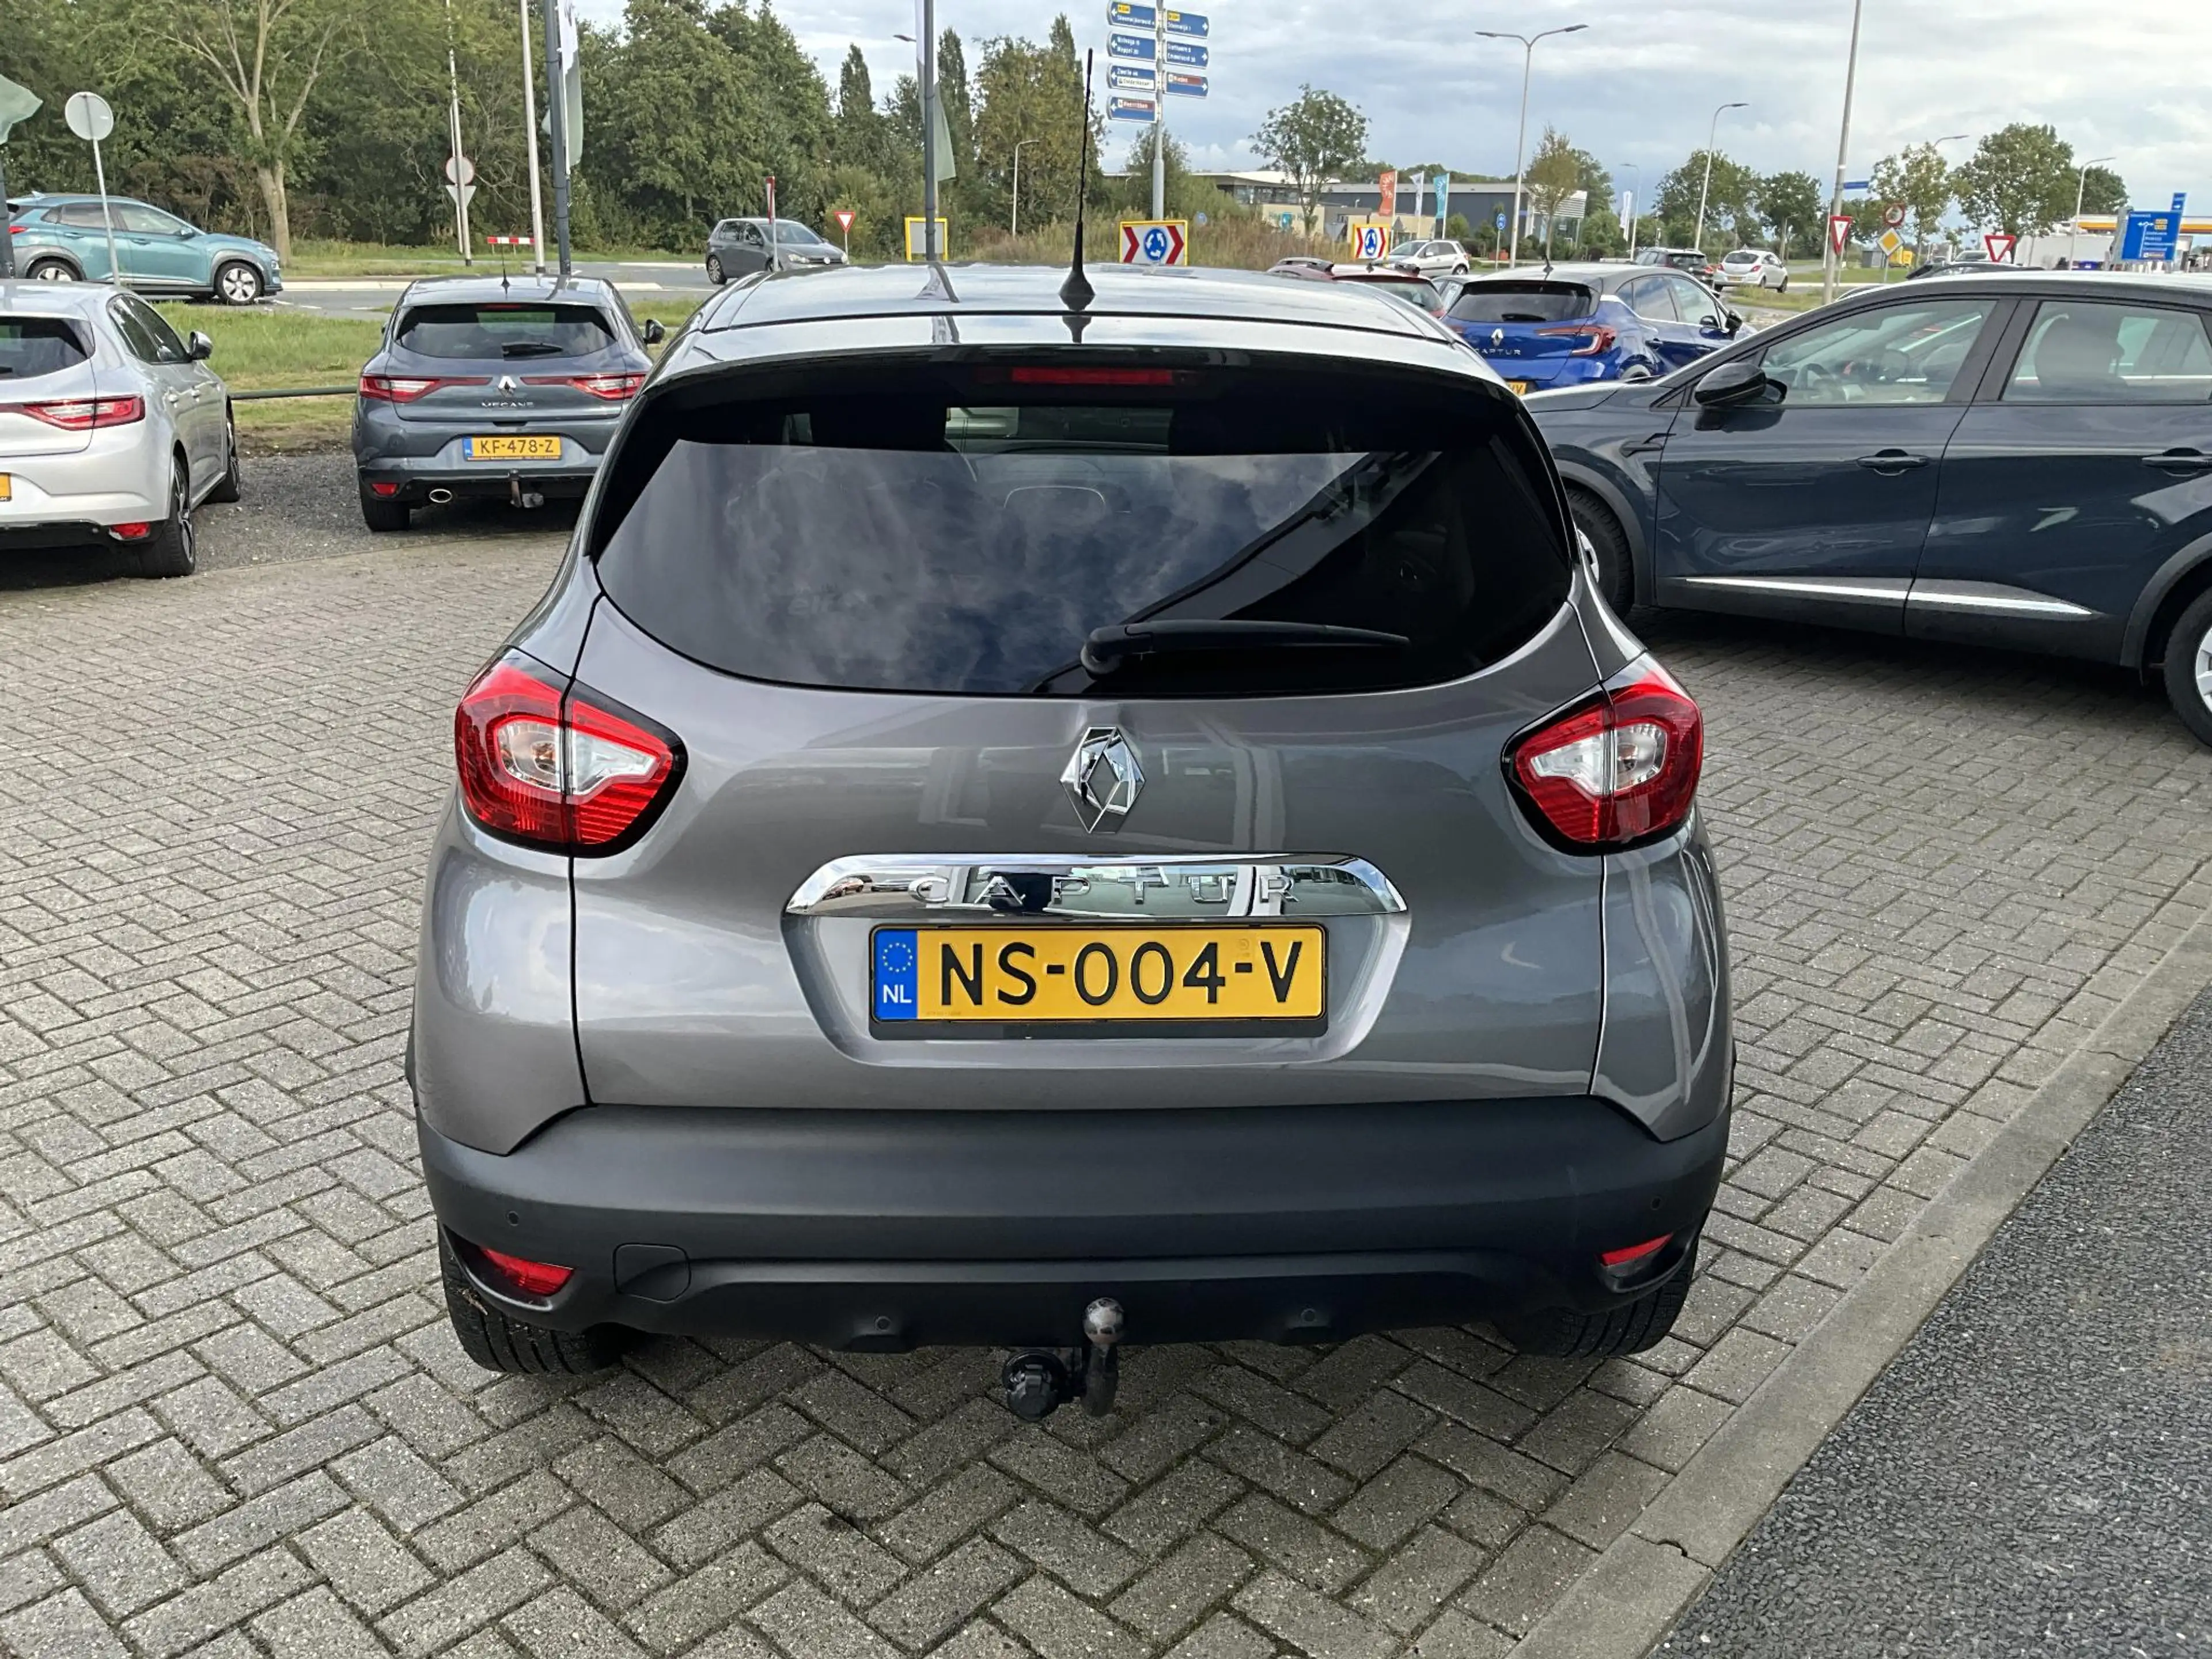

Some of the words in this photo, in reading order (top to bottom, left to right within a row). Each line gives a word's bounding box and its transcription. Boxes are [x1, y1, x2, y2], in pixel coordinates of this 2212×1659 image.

[480, 440, 554, 453] KF-478-Z
[908, 874, 1300, 906] CAPTUR
[941, 941, 1302, 1006] NS-004-V
[883, 984, 912, 1003] NL
